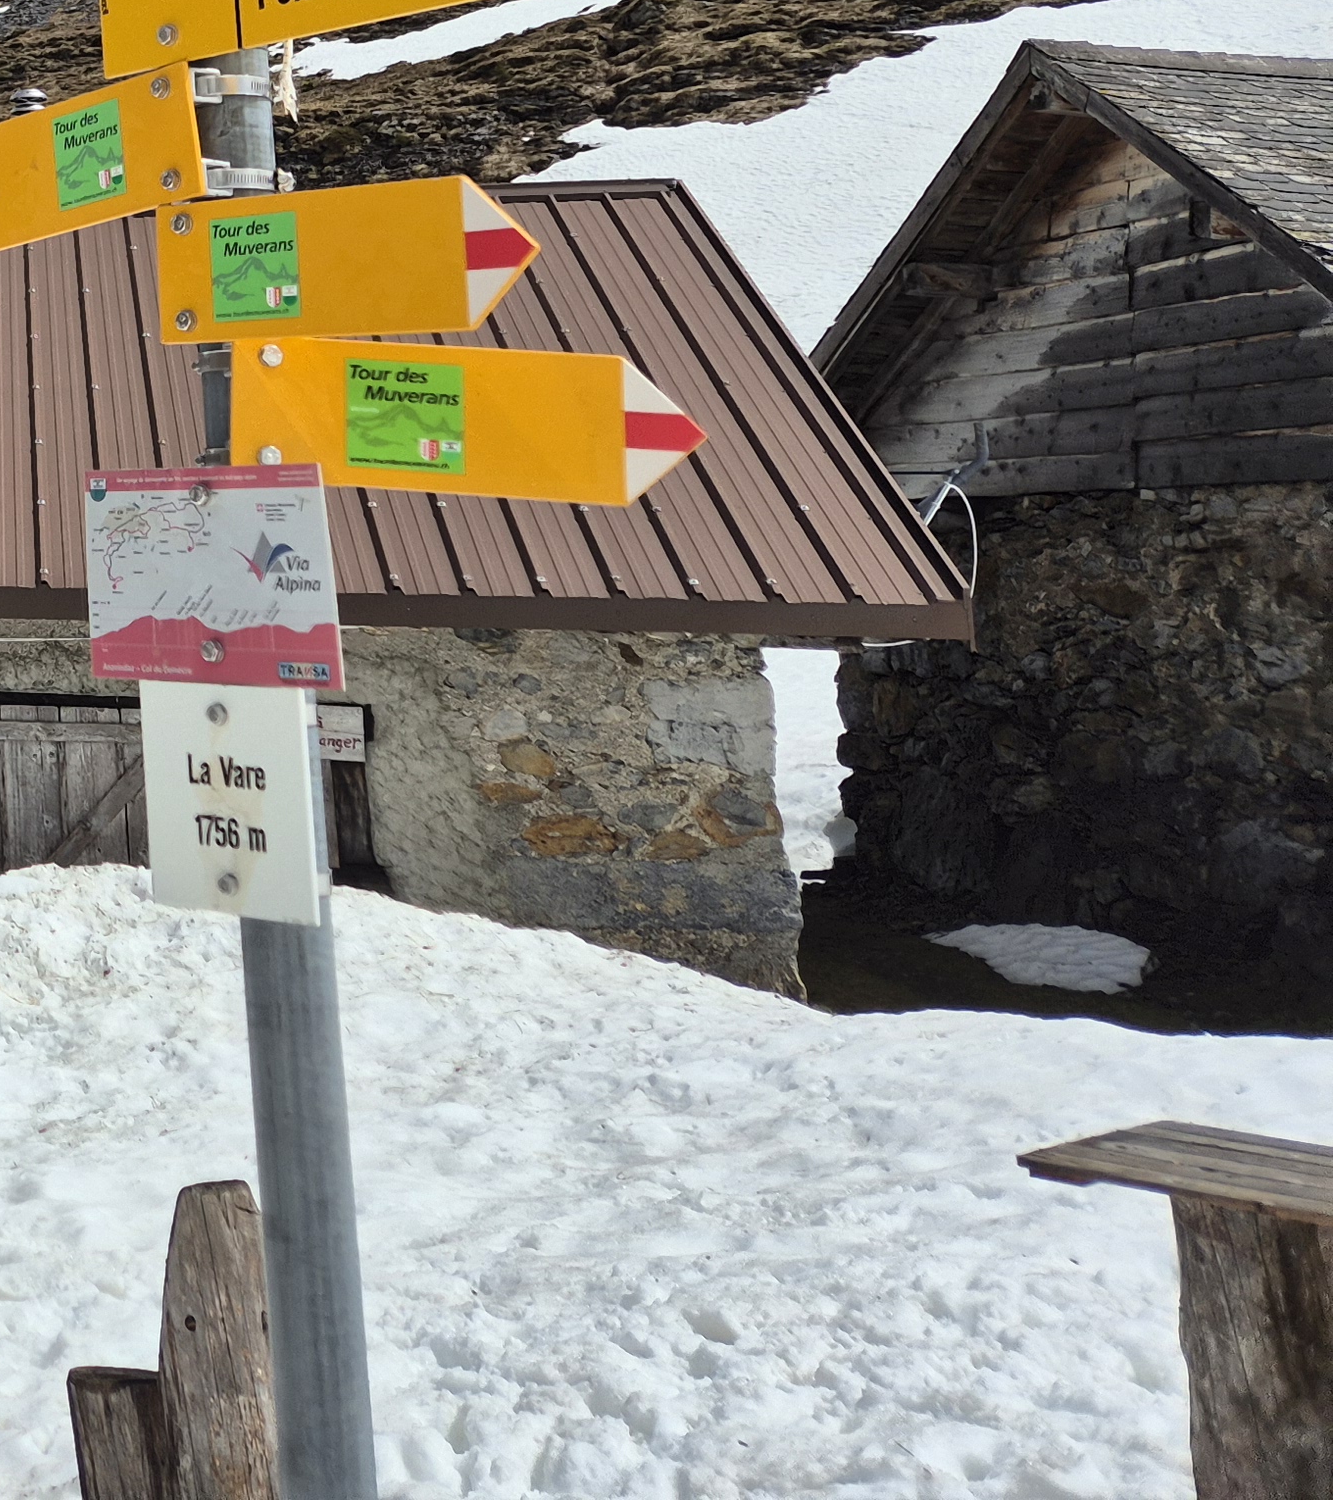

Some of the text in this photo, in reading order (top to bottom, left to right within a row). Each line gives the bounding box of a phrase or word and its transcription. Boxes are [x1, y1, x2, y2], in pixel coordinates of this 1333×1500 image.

[54, 112, 99, 136] Tour des
[64, 124, 118, 150] Muverans
[212, 220, 270, 239] Tour des
[224, 240, 294, 257] Muverans
[349, 364, 429, 384] Tour des
[364, 385, 460, 407] Muverans
[286, 556, 310, 571] Via
[274, 576, 321, 595] Alpina
[187, 752, 266, 791] La Vare
[195, 814, 267, 853] 1756 m
